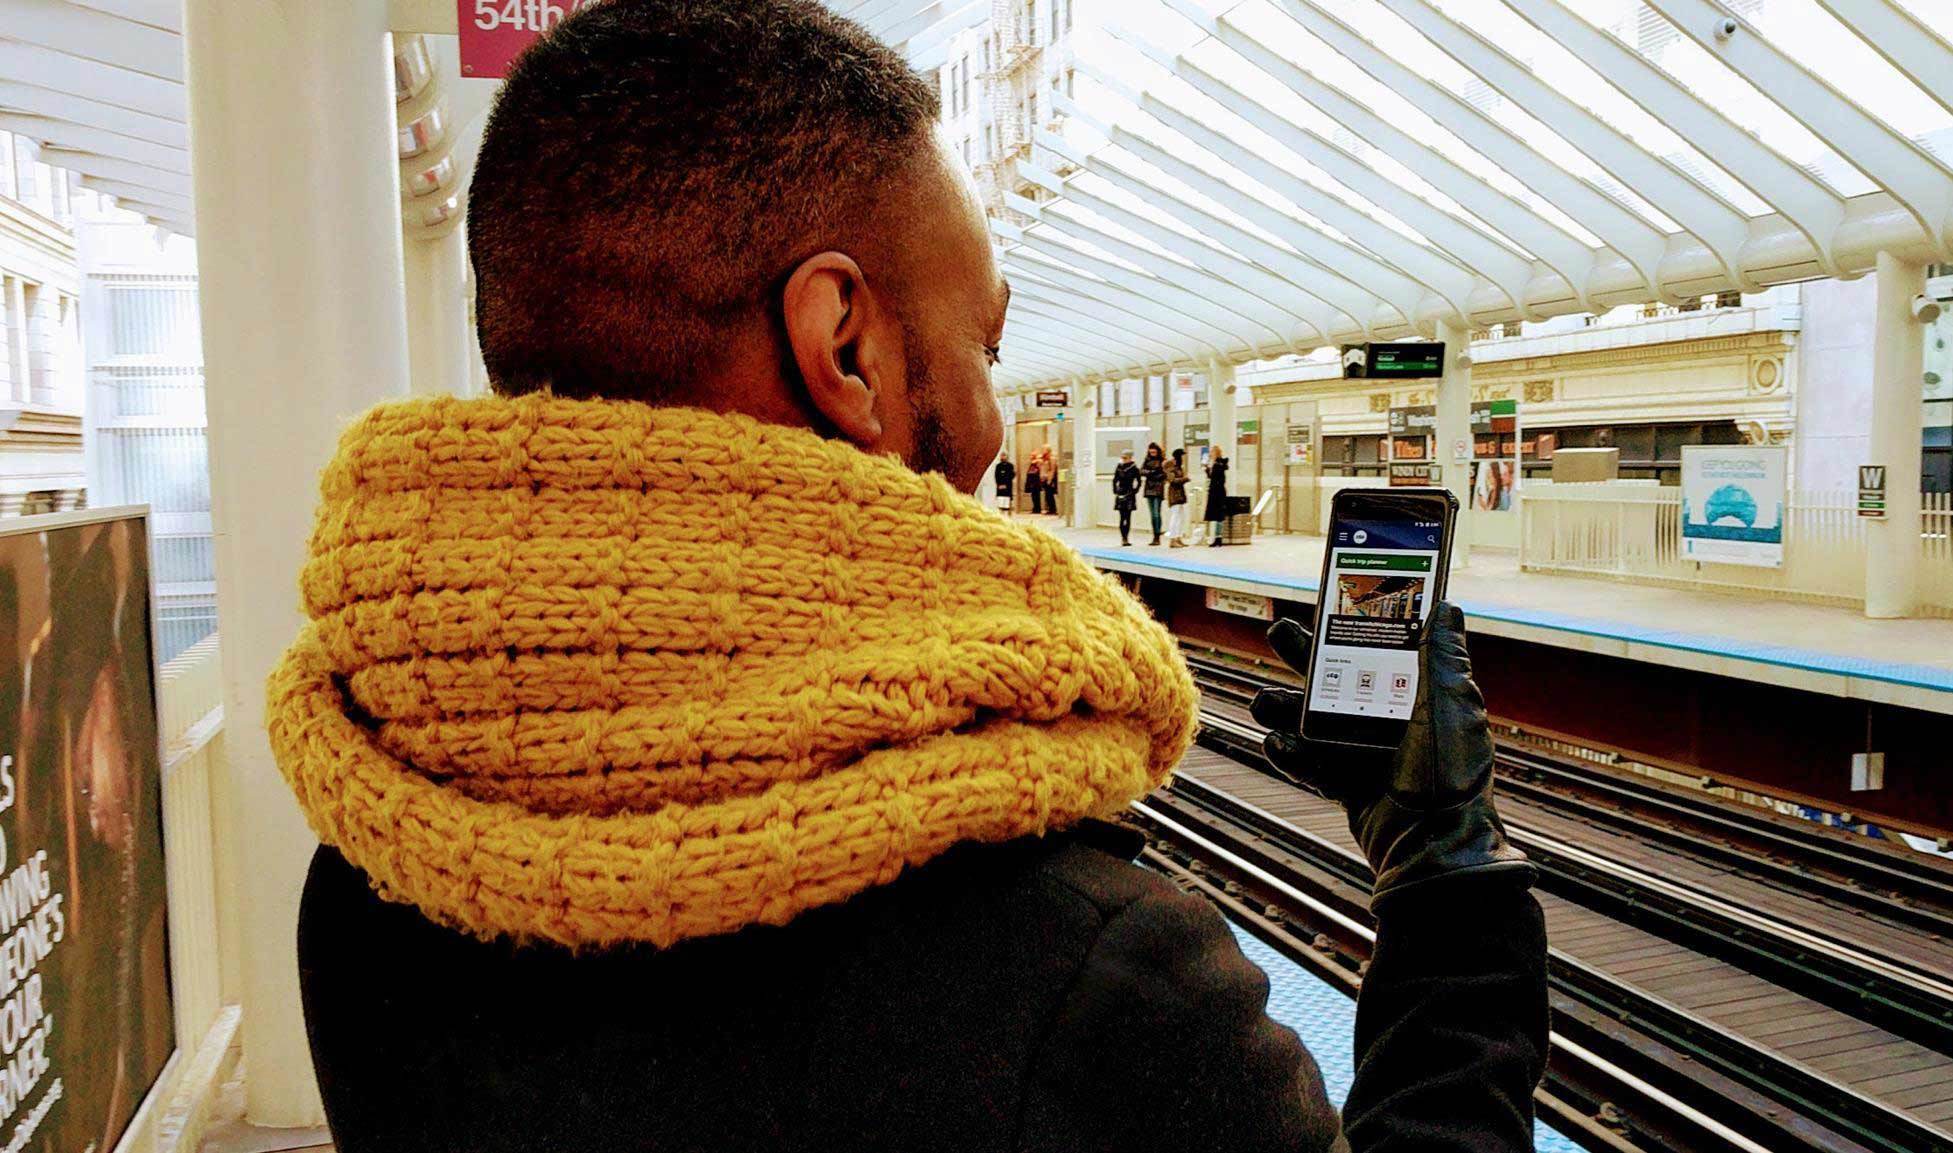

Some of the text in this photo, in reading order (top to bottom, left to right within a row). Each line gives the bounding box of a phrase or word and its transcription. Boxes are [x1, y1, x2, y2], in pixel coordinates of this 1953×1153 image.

[1862, 468, 1884, 489] W
[1340, 557, 1356, 565] Quick
[1357, 558, 1366, 566] trip
[0, 973, 43, 1054] OUR
